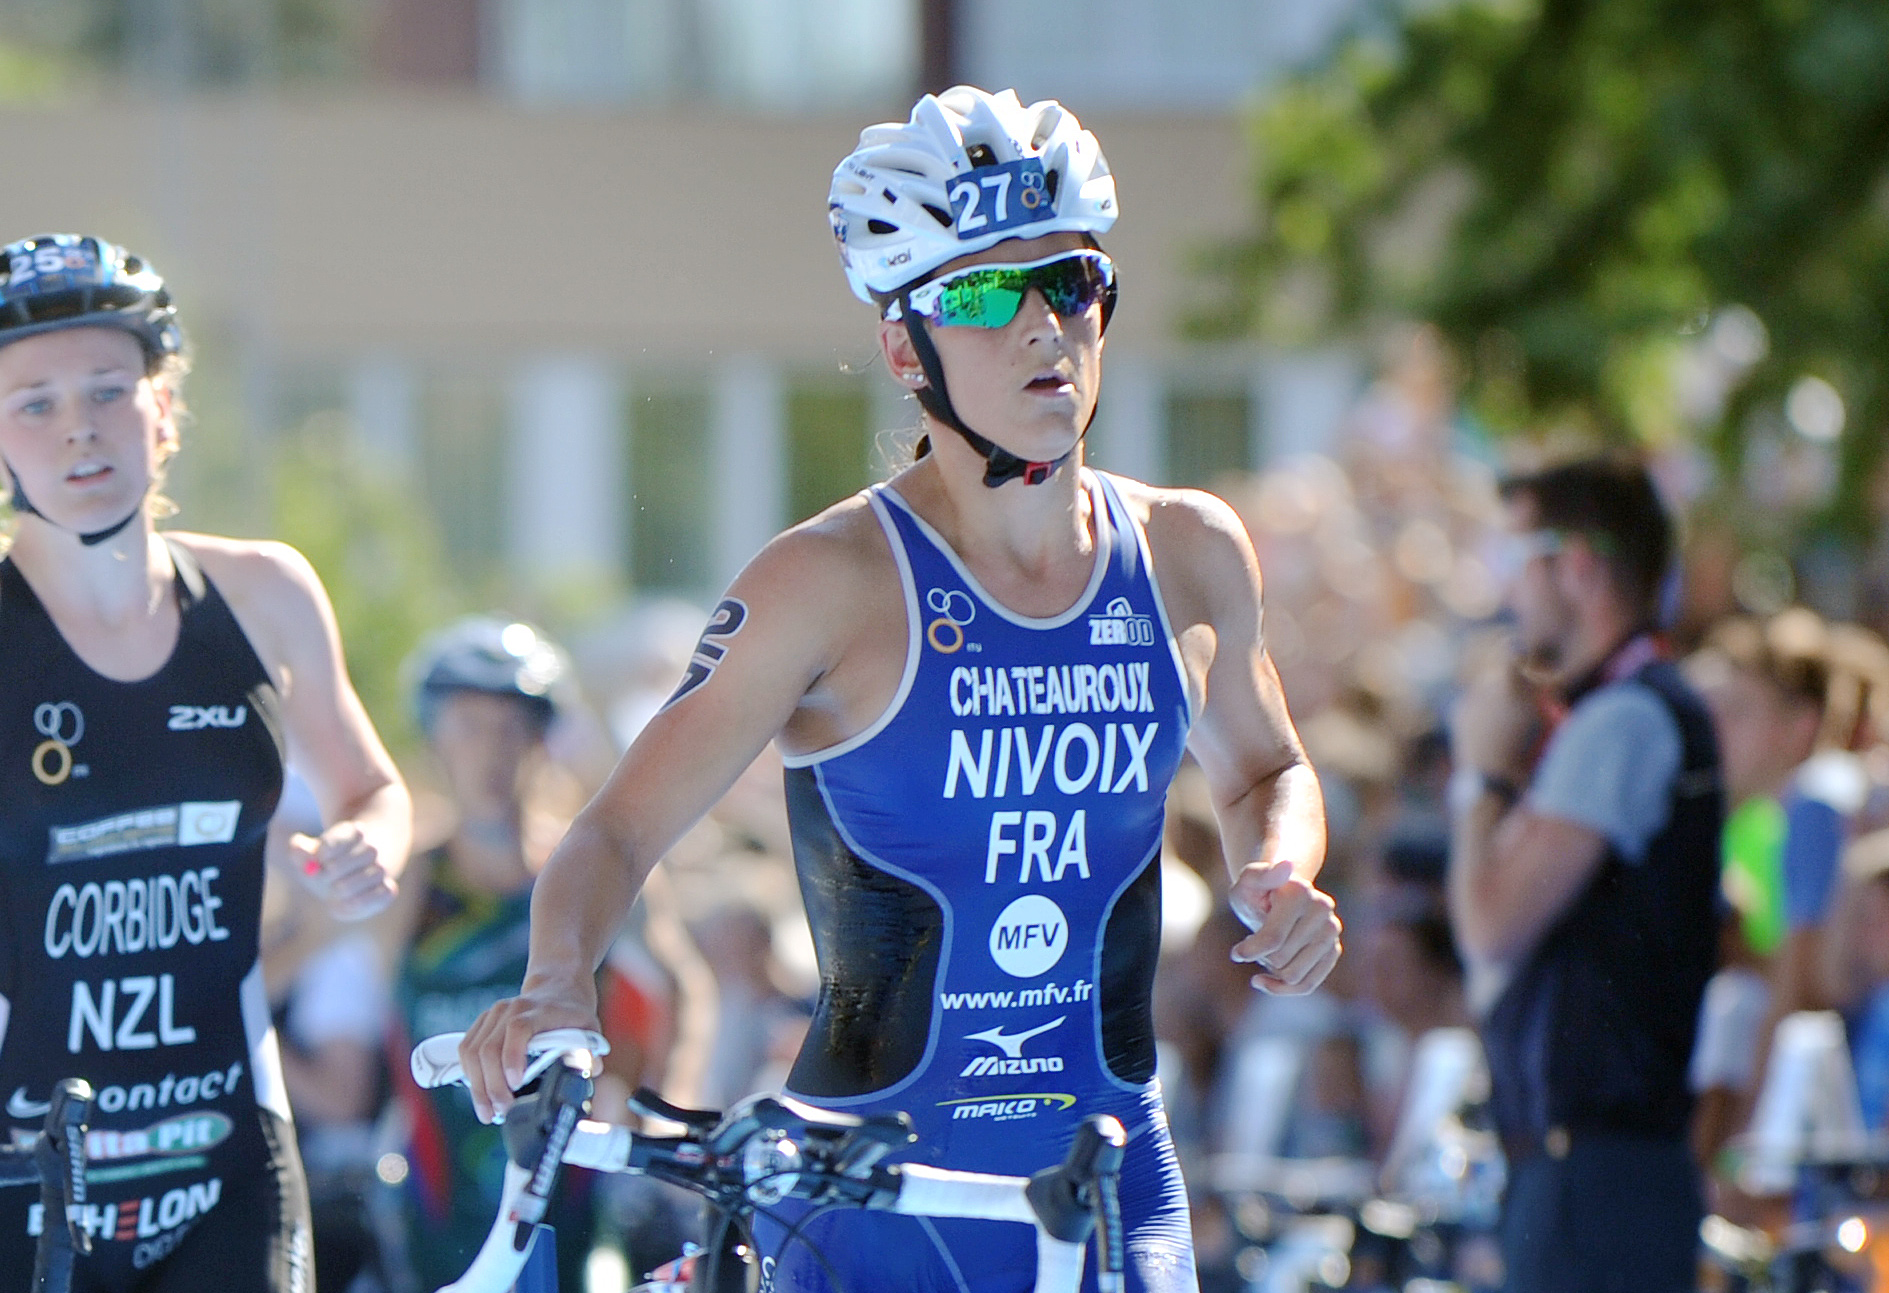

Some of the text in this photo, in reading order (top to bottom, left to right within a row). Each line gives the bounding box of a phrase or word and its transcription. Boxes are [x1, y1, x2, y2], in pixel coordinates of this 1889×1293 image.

[949, 171, 1013, 233] 27
[11, 246, 64, 287] 25
[949, 661, 1155, 716] CHATEAUROUX
[167, 705, 247, 731] 2XU
[943, 722, 1160, 799] NIVOIX
[984, 809, 1091, 884] FRA
[44, 866, 230, 959] CORBIDGE
[996, 922, 1060, 951] MFV
[68, 973, 197, 1053] NZL
[940, 979, 1093, 1010] www.mfv.fr
[90, 1060, 243, 1113] ontact
[953, 1099, 1037, 1120] MAKO
